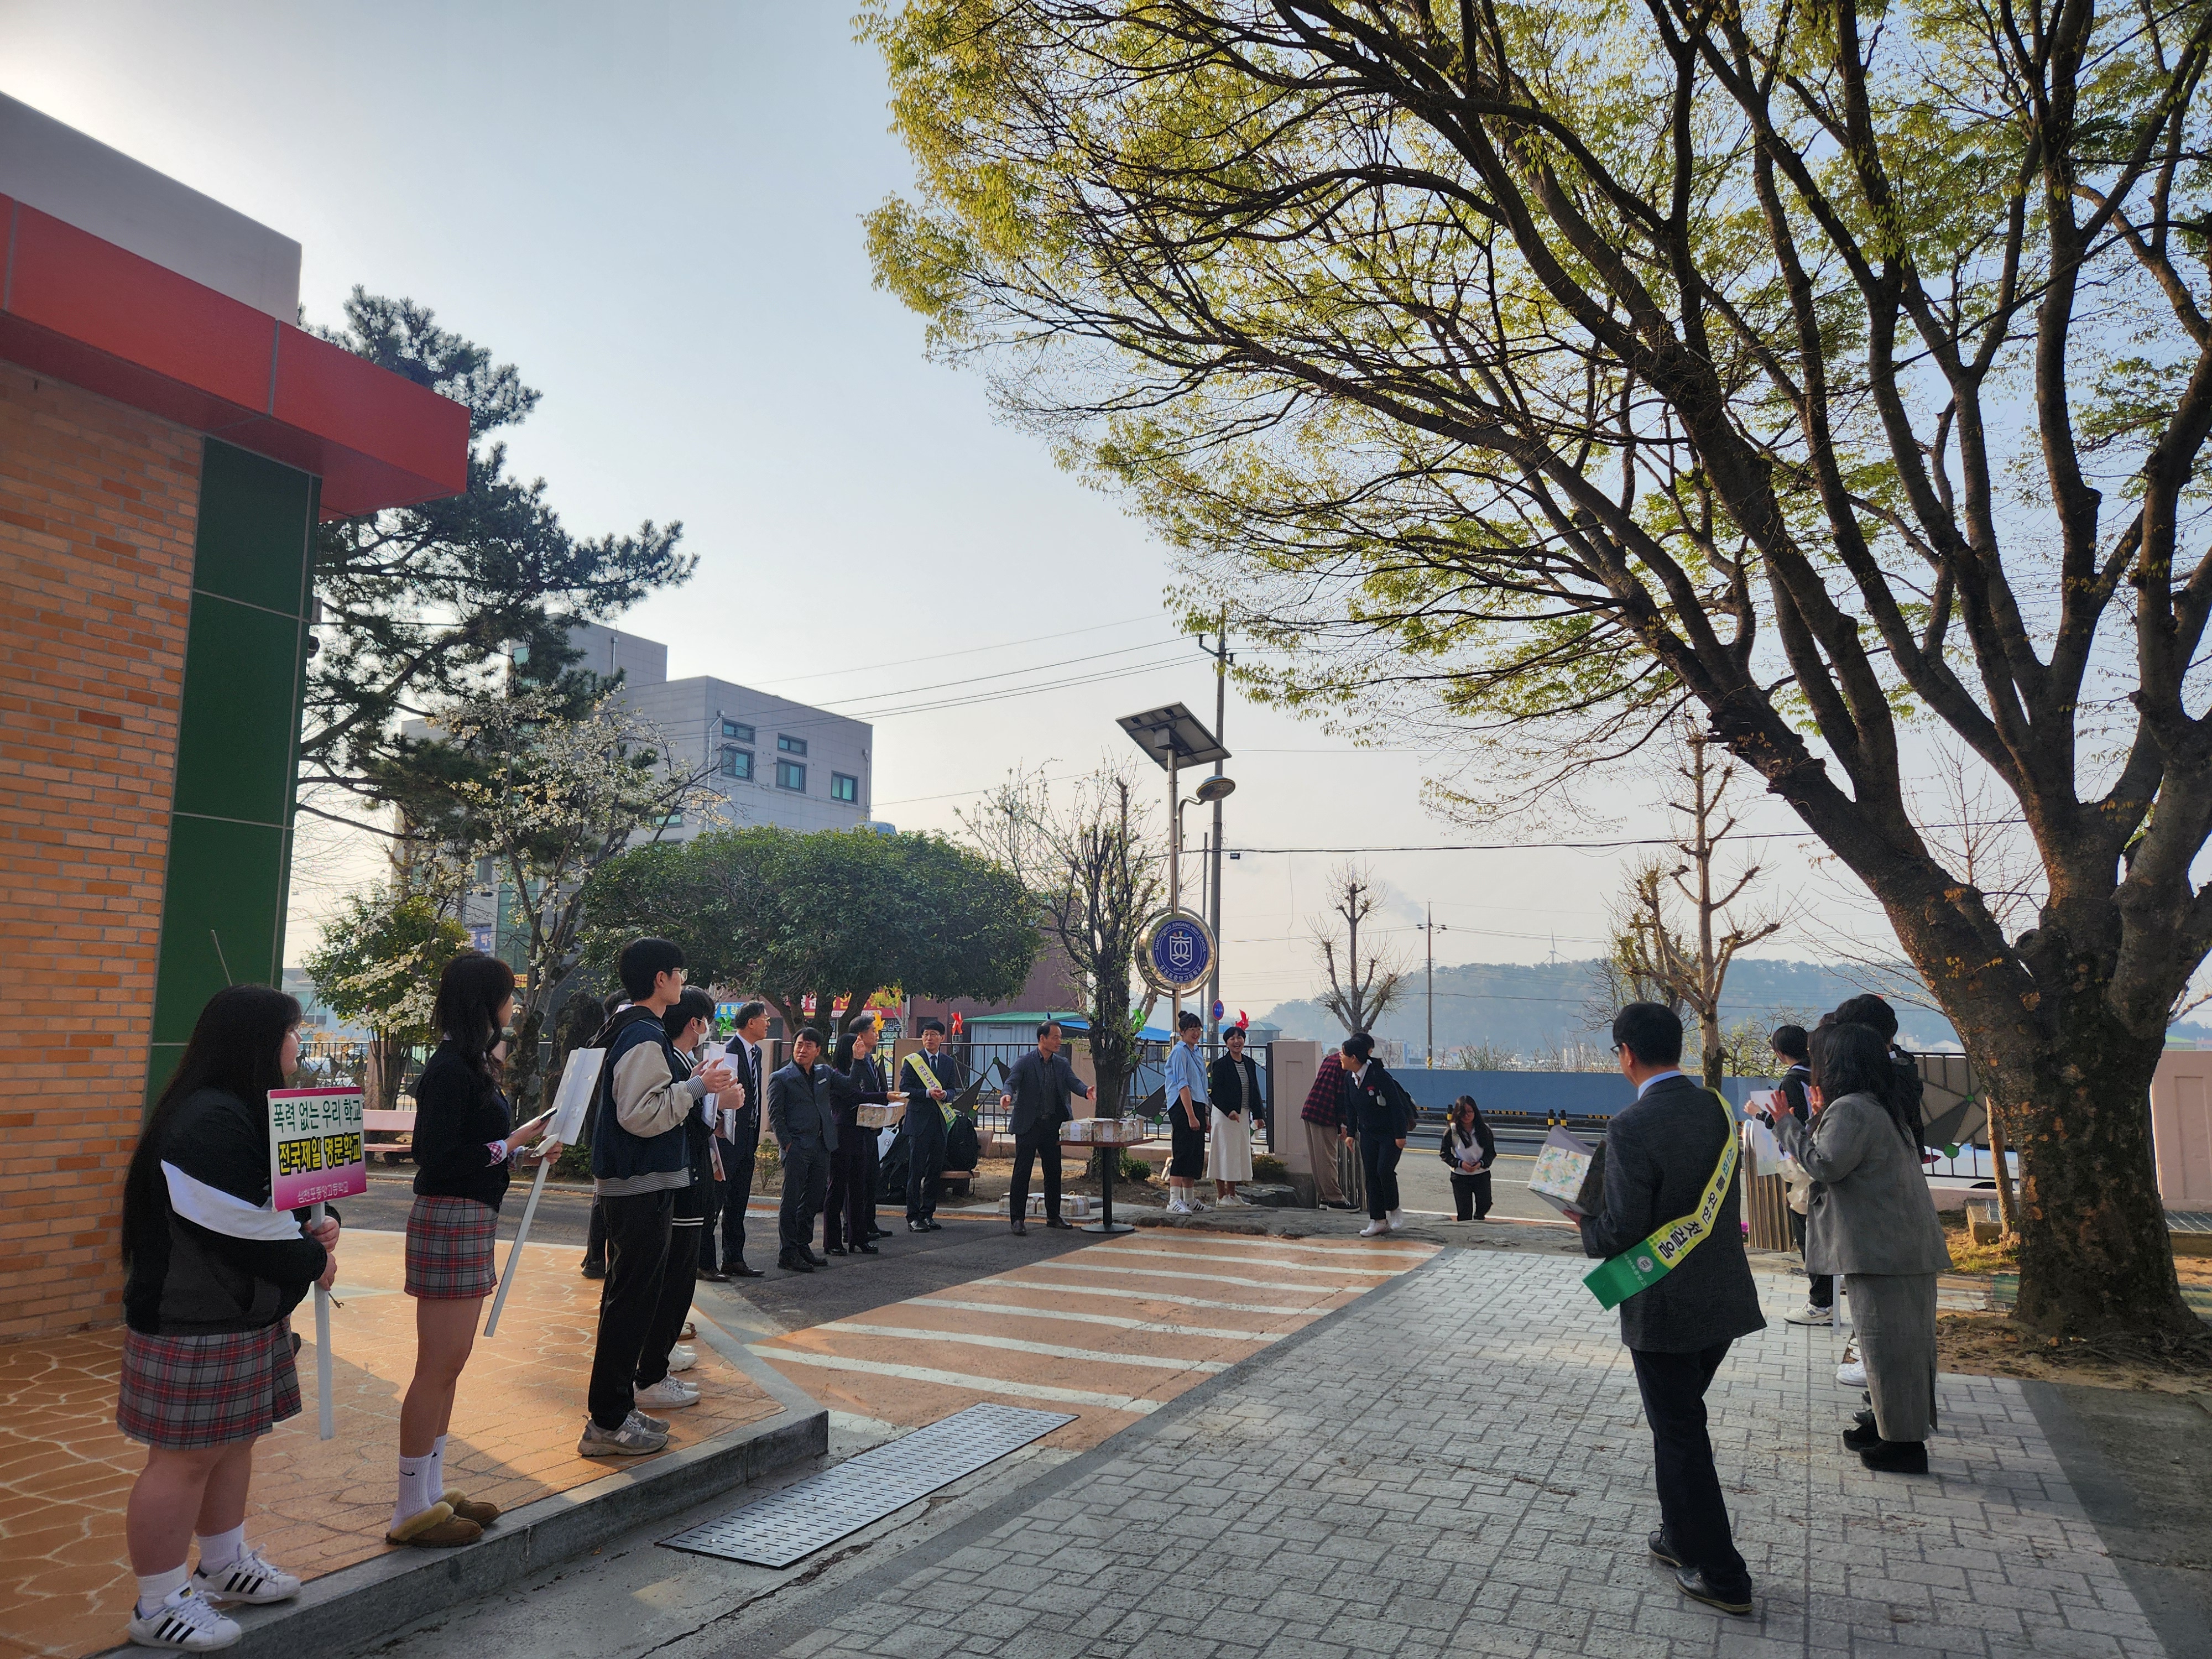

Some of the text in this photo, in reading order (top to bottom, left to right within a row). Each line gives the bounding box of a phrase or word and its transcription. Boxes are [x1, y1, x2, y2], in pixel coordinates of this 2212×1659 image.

[1155, 924, 1171, 951] SAMCHEONPO
[1190, 926, 1199, 936] HIGH
[1198, 935, 1207, 952] SCHOOL
[1160, 964, 1202, 982] 삼천포중앙고등학교
[273, 1099, 362, 1133] 폭력 없는 우리 학교
[278, 1132, 362, 1175] 전국제일 명문학교
[297, 1181, 349, 1203] 삼천포중앙고등학교
[1701, 1191, 1719, 1224] 위한
[1657, 1220, 1704, 1260] 첫걸음
